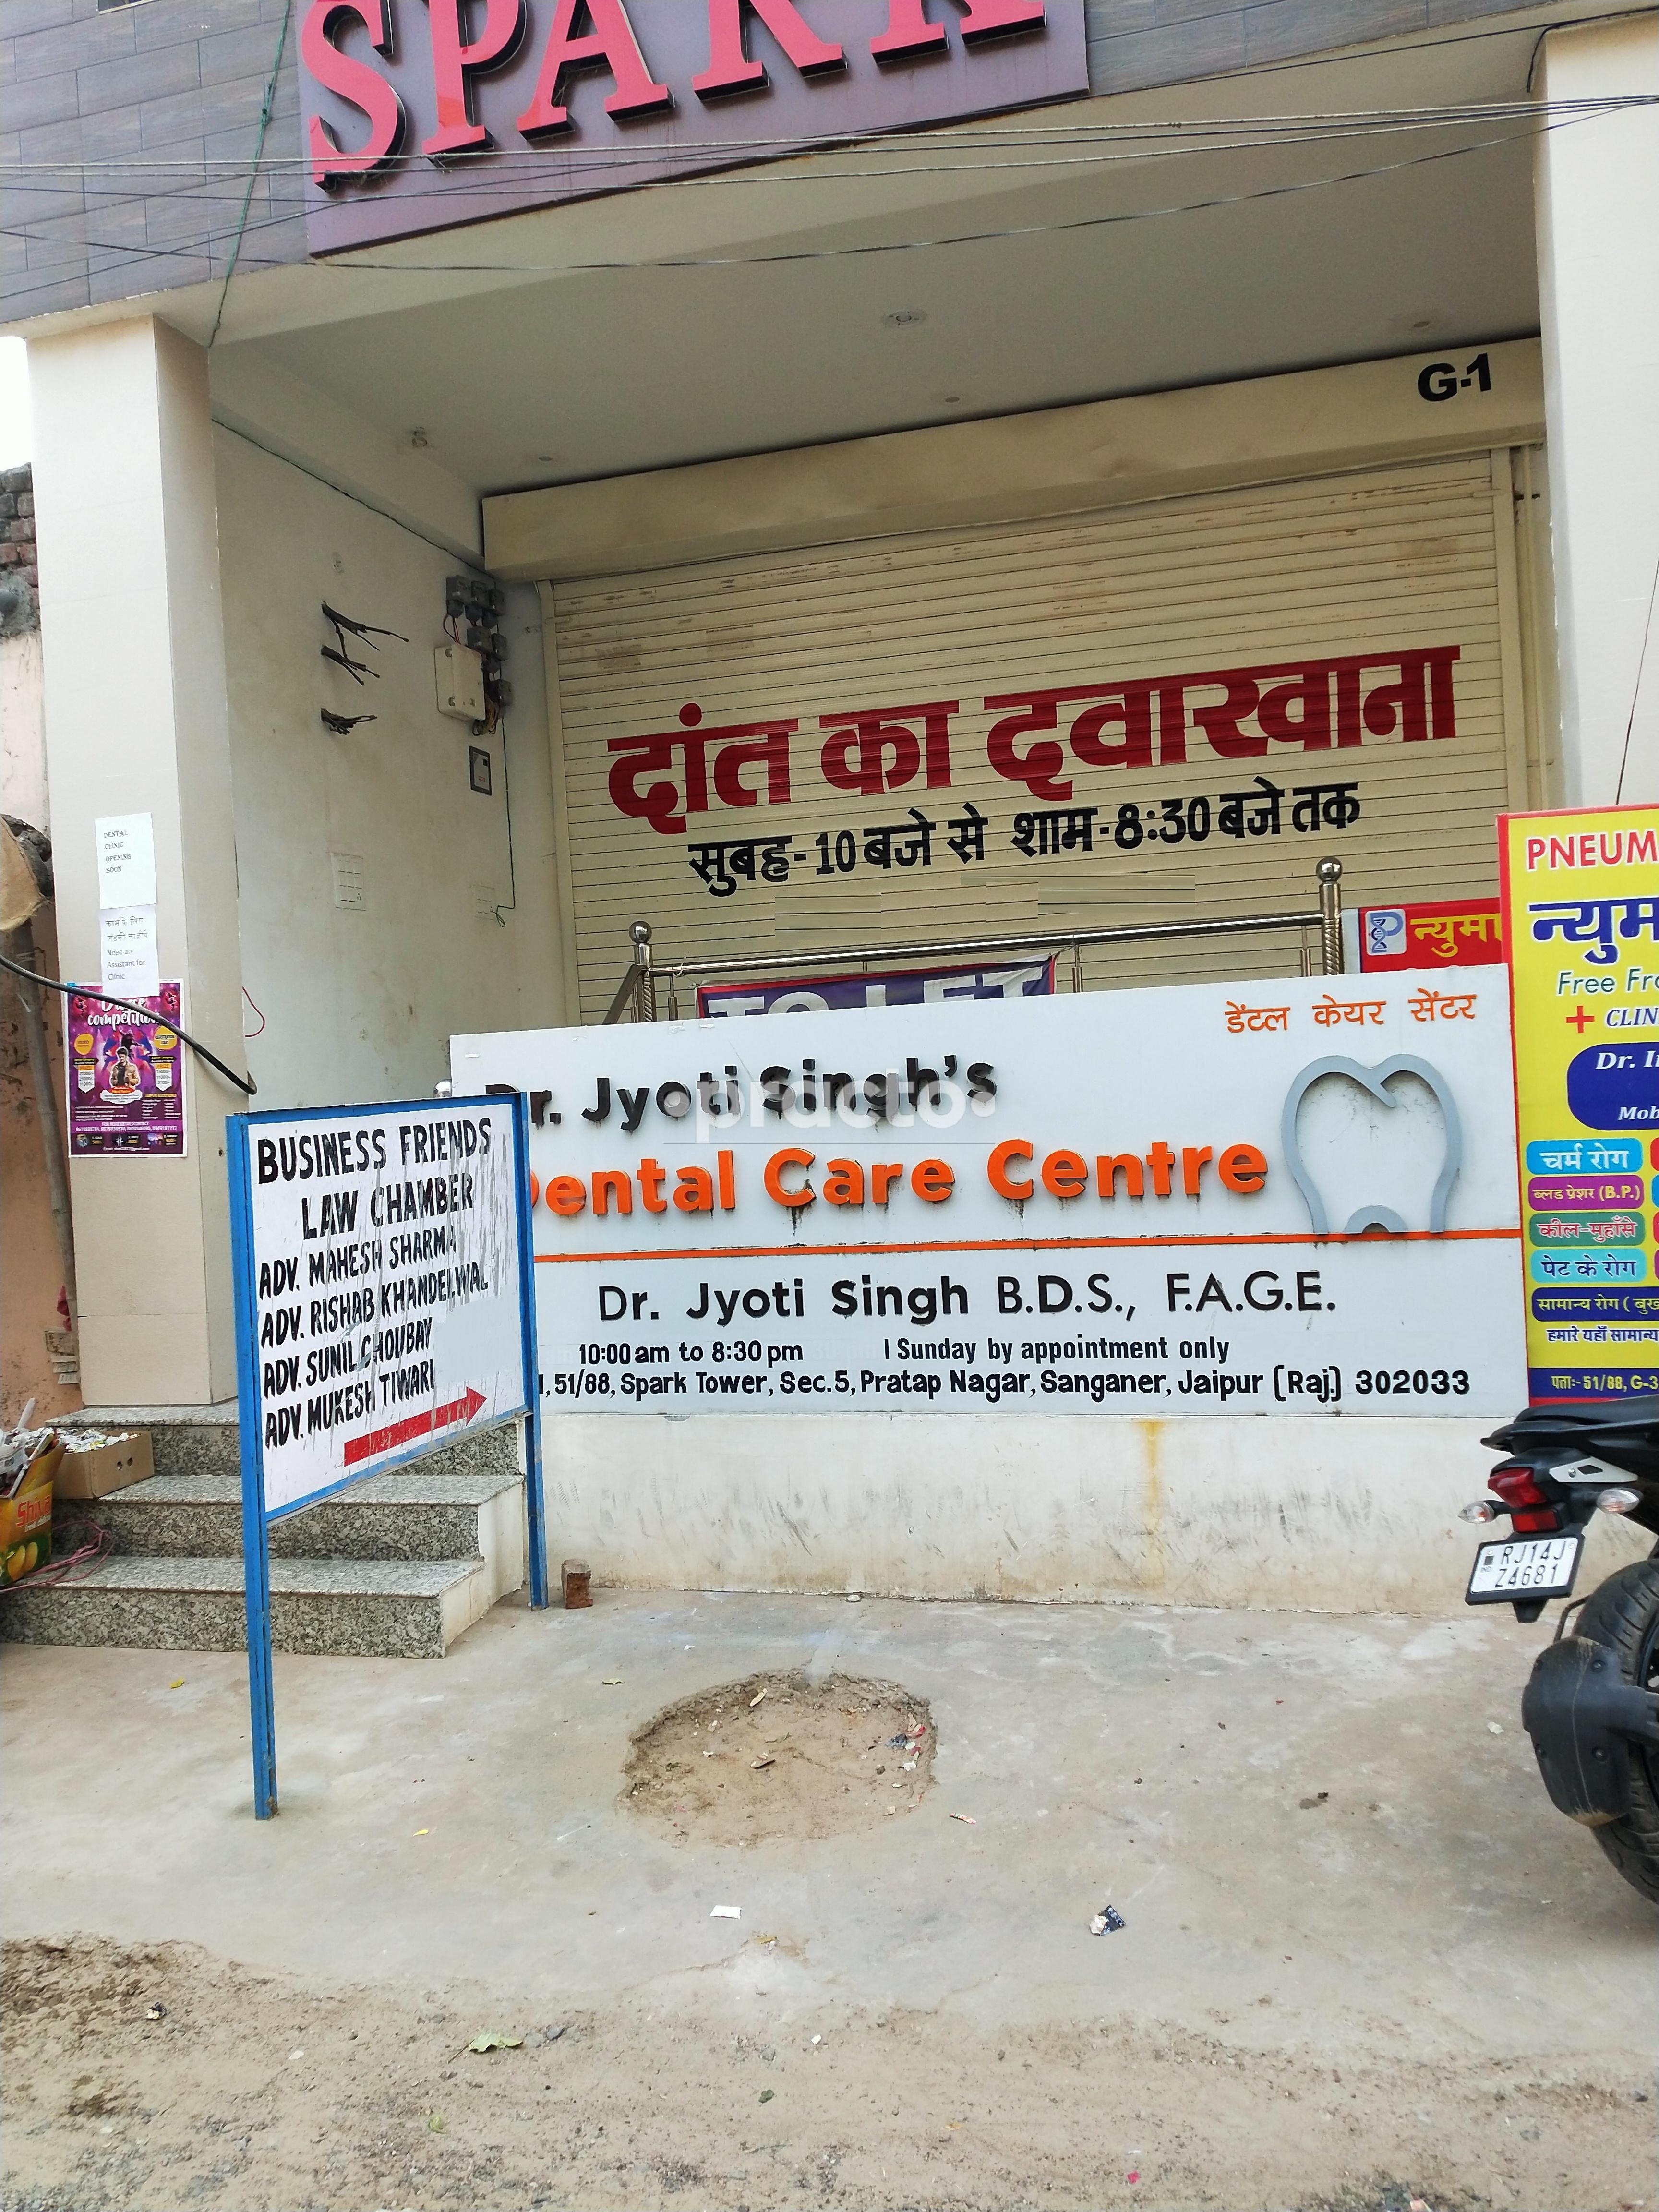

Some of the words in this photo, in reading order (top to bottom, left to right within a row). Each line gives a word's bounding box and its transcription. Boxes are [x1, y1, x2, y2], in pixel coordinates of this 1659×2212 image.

[301, 0, 1046, 188] SPA
[1418, 352, 1491, 401] G-1
[607, 702, 799, 834] दांत
[819, 699, 959, 795] का
[948, 802, 989, 864] से
[1528, 831, 1658, 869] PNEUM
[106, 854, 131, 862] OPENING
[1558, 972, 1615, 994] Free
[1225, 1001, 1290, 1033] डेंटल
[1312, 994, 1386, 1027] केयर
[1408, 988, 1477, 1022] सेंटर
[1595, 1052, 1635, 1070] Dr.
[485, 1084, 561, 1126] r.
[581, 1065, 740, 1131] Jyoti
[258, 1128, 387, 1184] BUSINESS
[399, 1118, 491, 1165] FRIENDS
[1539, 1143, 1583, 1170] चर्म
[1587, 1142, 1629, 1169] रोग
[764, 1148, 955, 1208] Care
[987, 1139, 1268, 1200] Centre
[1599, 1185, 1640, 1201] (B.P.)
[301, 1190, 359, 1240] LAW
[370, 1173, 473, 1227] CHAMBER
[259, 1257, 300, 1301] ADV.
[308, 1239, 382, 1288] MAHESH
[389, 1226, 457, 1270] SHARMA
[1540, 1255, 1571, 1277] पेट
[1575, 1254, 1598, 1277] के
[1601, 1254, 1637, 1276] रोग
[261, 1305, 304, 1349] ADV.
[310, 1287, 374, 1337] RISHAB
[381, 1262, 489, 1319] KHANDELWAL
[599, 1286, 659, 1321] Dr.
[686, 1278, 805, 1326] Jyoti
[831, 1274, 968, 1326] Singh
[1167, 1270, 1336, 1313] F.A.G.E.
[1537, 1299, 1591, 1311] सामान्य
[1594, 1294, 1619, 1310] रोग
[679, 1341, 704, 1363] to
[897, 1338, 976, 1364] Sunday
[988, 1337, 1012, 1365] by
[1021, 1334, 1168, 1364] appointment
[1179, 1336, 1230, 1364] only
[1547, 1326, 1579, 1342] हमारे
[264, 1355, 302, 1400] ADV.
[306, 1340, 357, 1386] SUNIL
[621, 1371, 687, 1401] Spark
[695, 1371, 774, 1397] Tower,
[860, 1370, 941, 1399] Pratap
[950, 1369, 1036, 1403] Nagar,
[1040, 1369, 1171, 1403] Sanganer,
[1178, 1370, 1263, 1401] Jaipur
[1355, 1370, 1470, 1395] 302033
[1584, 1374, 1627, 1392] 51/88,
[265, 1403, 304, 1450] ADV.
[307, 1380, 376, 1435] MUKESH
[379, 1358, 434, 1407] TIWARI
[1501, 1541, 1567, 1565] RJ14J
[1494, 1563, 1558, 1588] Z4681
